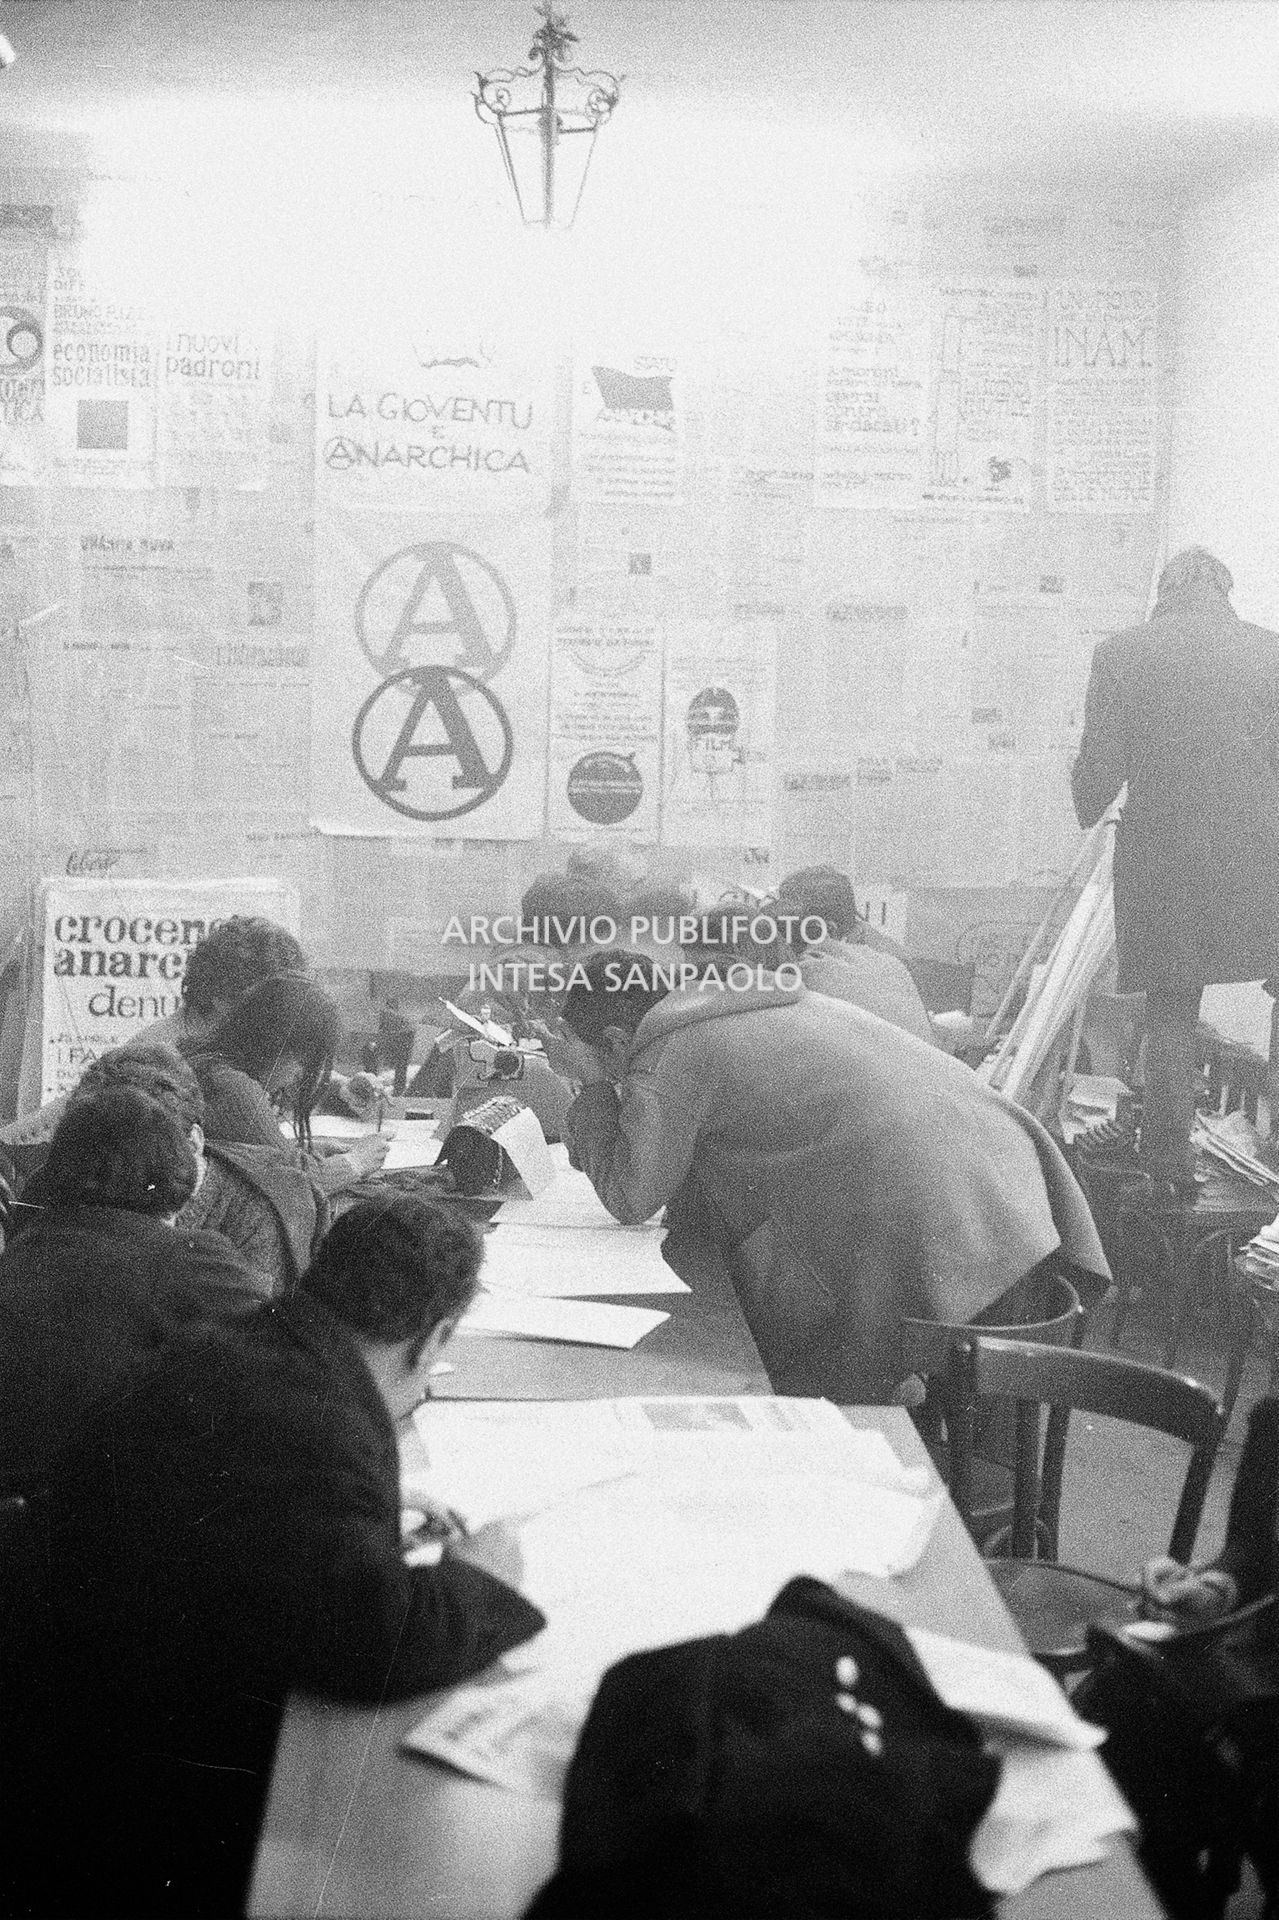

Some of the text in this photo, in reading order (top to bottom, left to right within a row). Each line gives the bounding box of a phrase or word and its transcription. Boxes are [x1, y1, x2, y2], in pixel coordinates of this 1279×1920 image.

[53, 342, 150, 365] economia
[176, 332, 240, 354] nuovi
[53, 364, 151, 388] socialista
[165, 354, 260, 381] padroni
[327, 391, 533, 430] LA GIOVENTU
[323, 435, 530, 474] ANARCHICA
[53, 948, 186, 980] anarc
[88, 983, 182, 1019] denu
